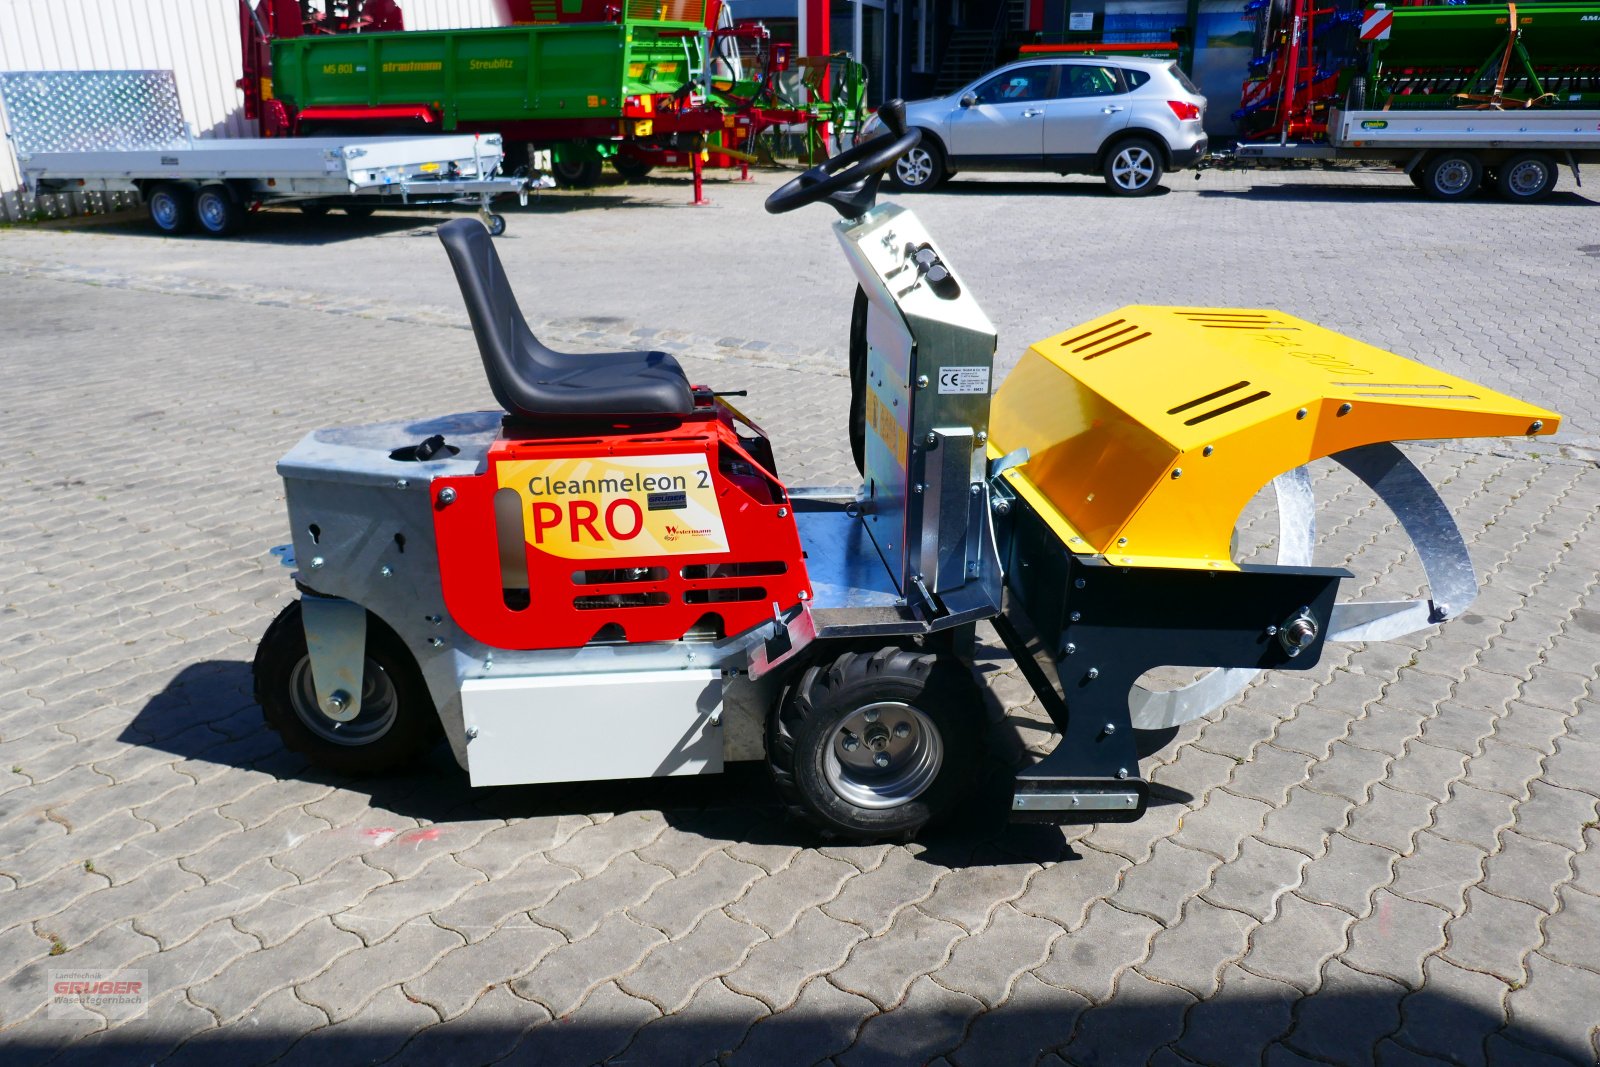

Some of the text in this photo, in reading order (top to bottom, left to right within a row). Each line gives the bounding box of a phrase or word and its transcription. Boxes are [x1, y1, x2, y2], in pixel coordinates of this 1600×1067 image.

[323, 63, 353, 74] MS 801
[470, 59, 514, 70] Streublitz
[528, 470, 710, 496] Cleanmeleon 2
[648, 494, 686, 502] GRUBER
[531, 498, 644, 545] PRO
